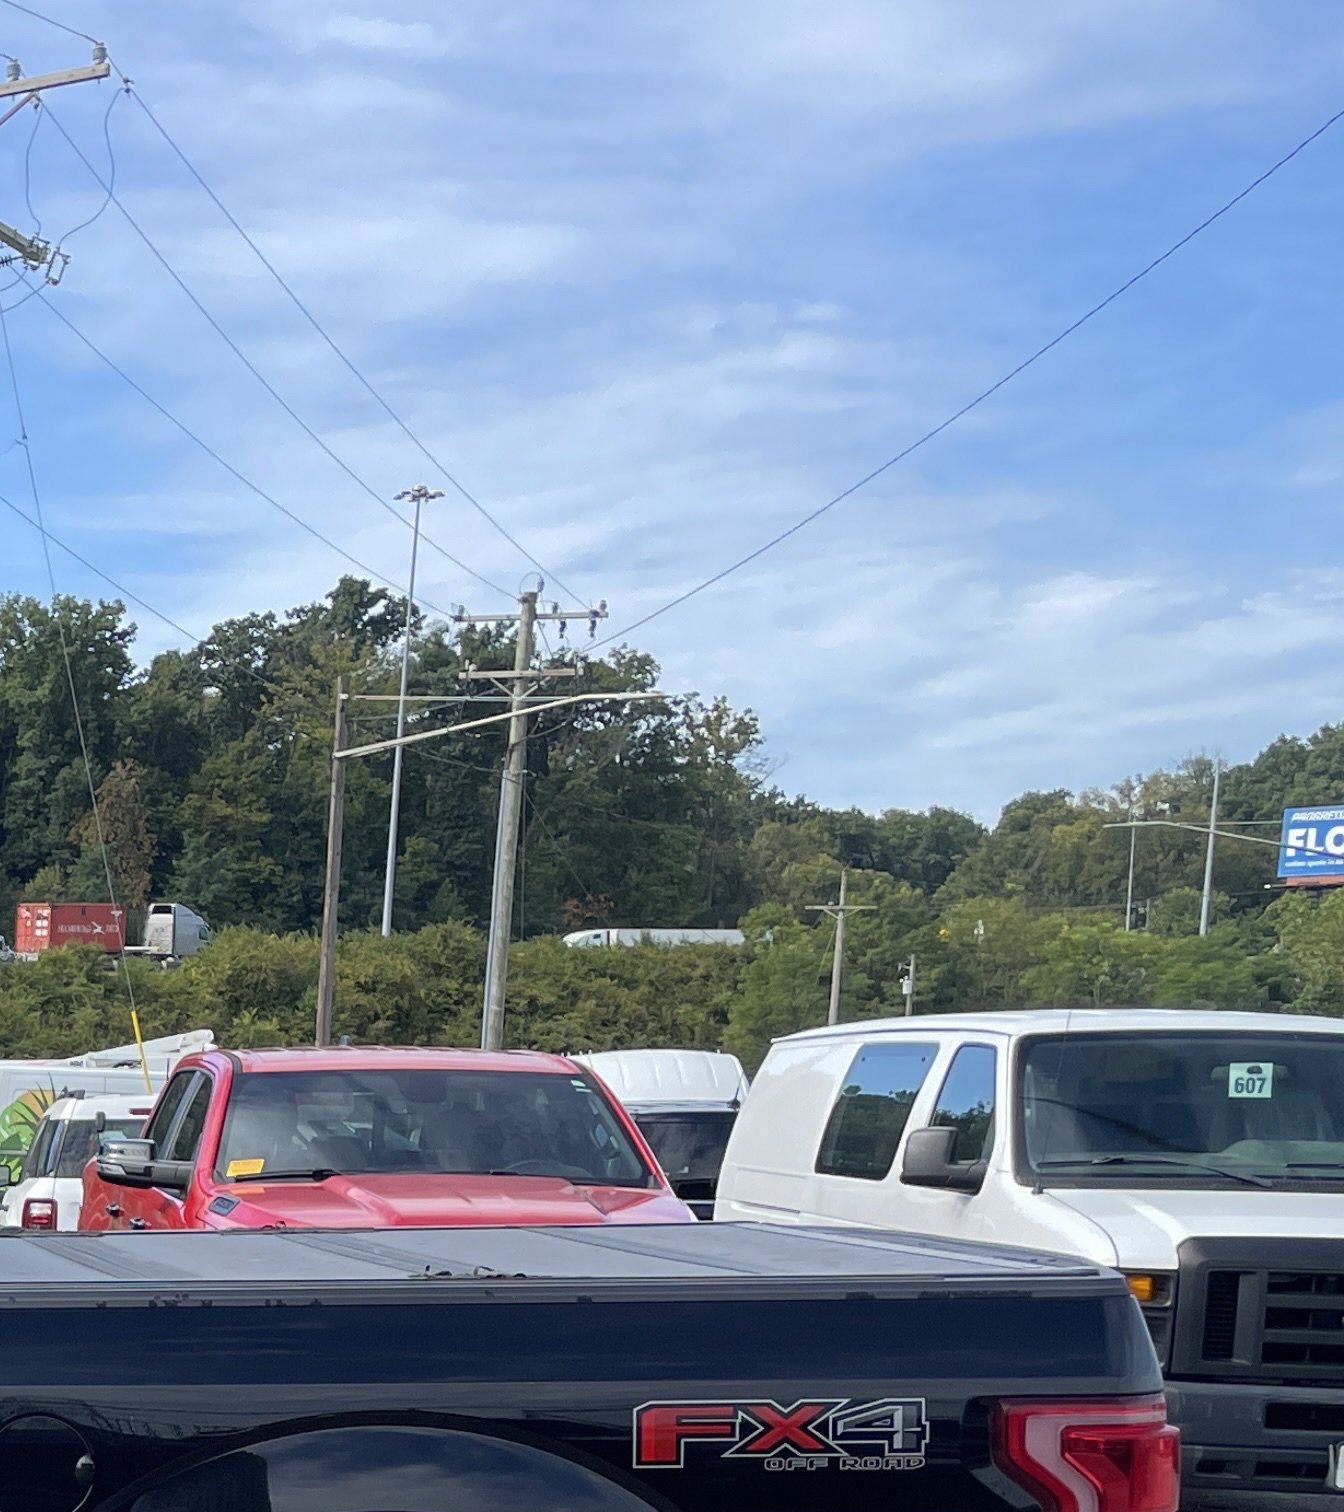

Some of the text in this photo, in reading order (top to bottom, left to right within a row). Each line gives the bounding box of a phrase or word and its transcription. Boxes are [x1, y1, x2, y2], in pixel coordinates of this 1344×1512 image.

[1234, 1077, 1267, 1094] 607
[632, 1397, 931, 1470] FX4
[764, 1456, 927, 1472] OFF ROAD
